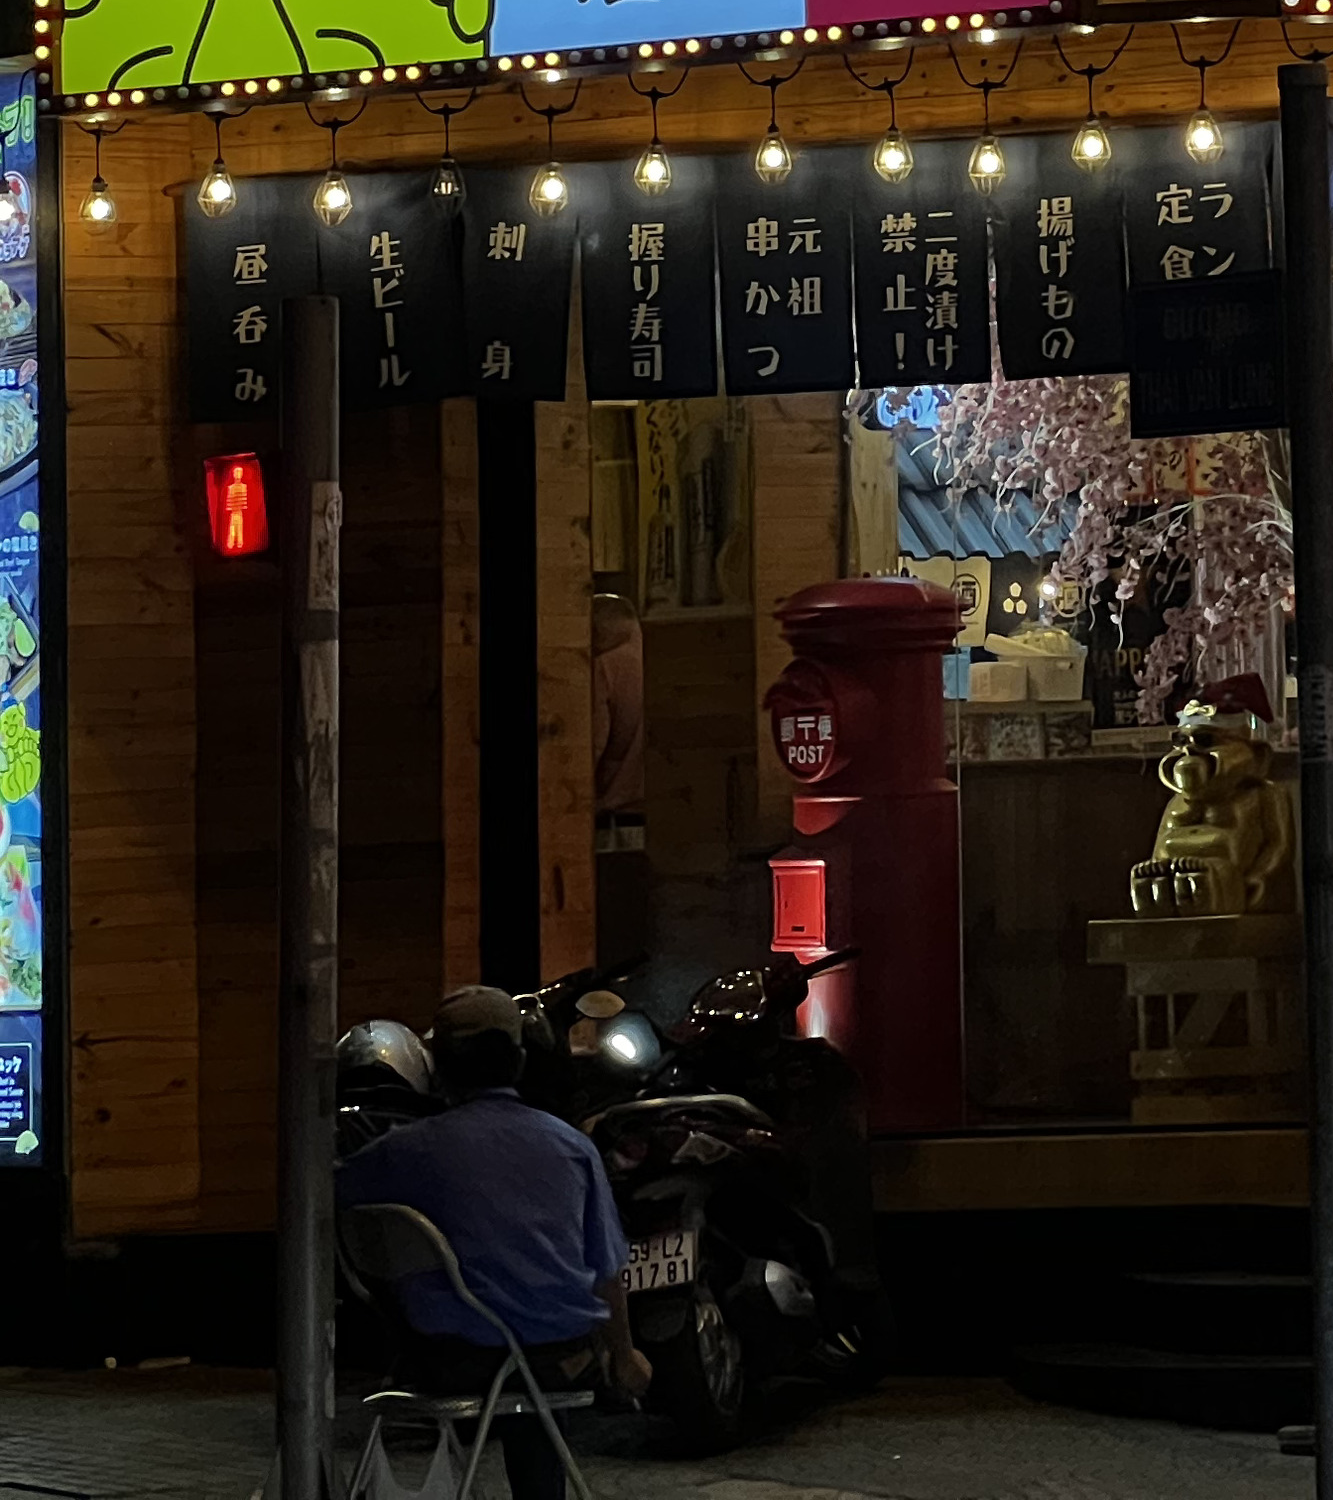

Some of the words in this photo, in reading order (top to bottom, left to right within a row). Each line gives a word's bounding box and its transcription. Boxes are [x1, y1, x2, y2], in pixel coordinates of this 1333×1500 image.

[481, 221, 527, 380] 刺身
[628, 222, 665, 382] 握り寿司
[745, 216, 781, 377] 串かつ
[787, 217, 823, 316] 元祖
[924, 211, 960, 372] 二度漬け
[1037, 196, 1075, 361] 揚げもの
[1155, 183, 1195, 281] 定食
[1199, 181, 1236, 277] ラン
[233, 244, 268, 402] 昼呑み
[369, 230, 411, 390] 生ビール
[787, 744, 825, 765] POST
